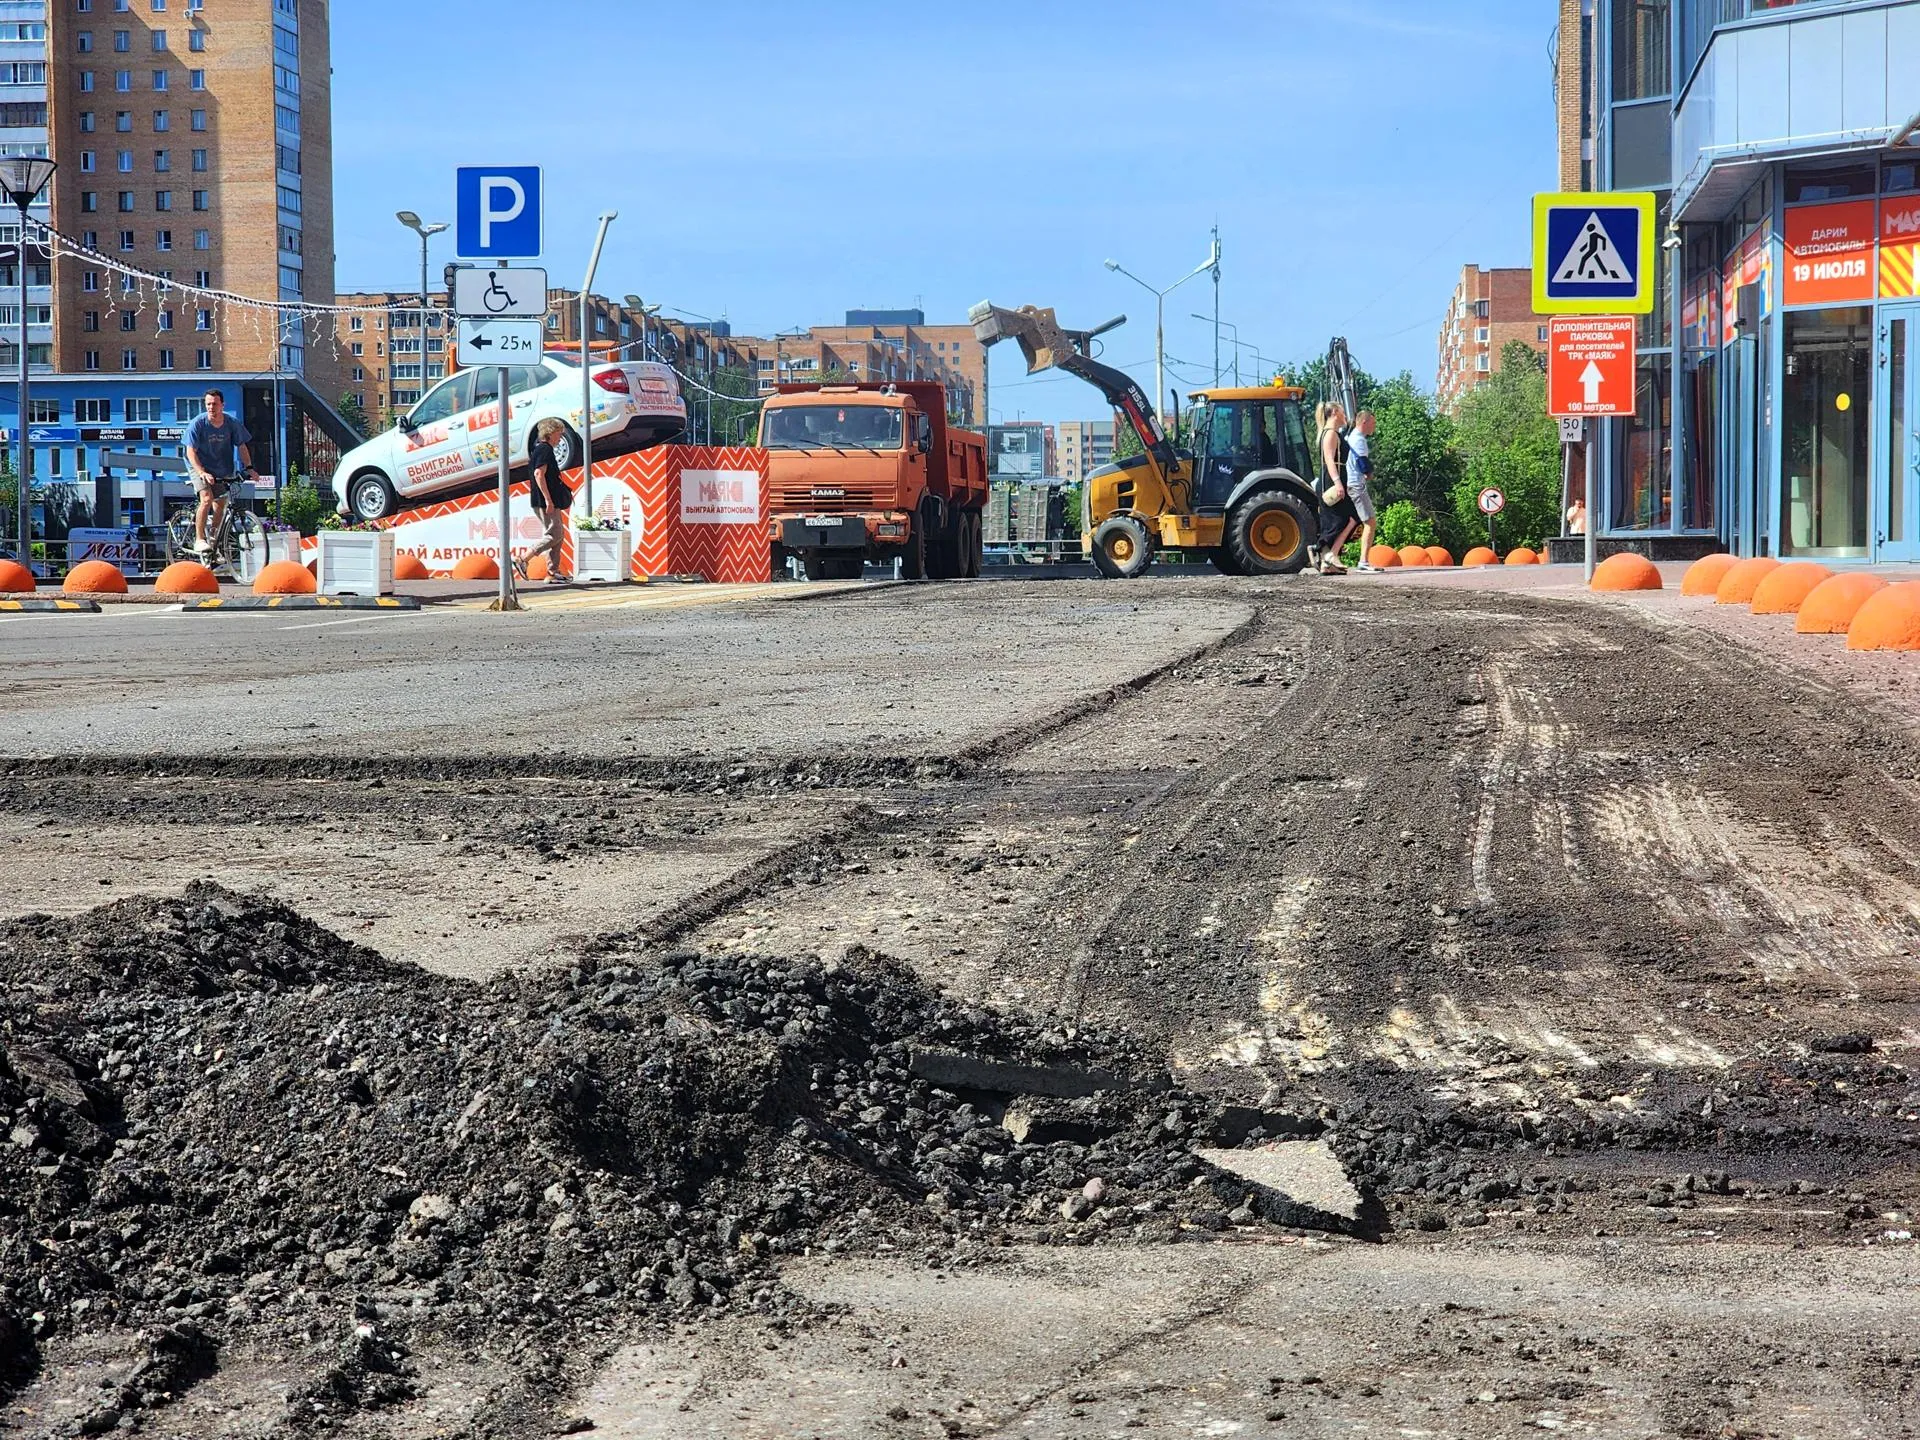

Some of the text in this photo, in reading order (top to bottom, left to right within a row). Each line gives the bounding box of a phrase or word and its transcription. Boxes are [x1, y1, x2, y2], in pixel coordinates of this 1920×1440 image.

[479, 176, 526, 248] P
[1811, 227, 1848, 241] ДАРИМ
[1793, 259, 1866, 282] 19 ИЮЛЯ
[1553, 322, 1631, 333] ДОПОЛНИТЕЛЬНАЯ
[501, 335, 519, 350] 25
[1570, 332, 1614, 341] ПАРКОВКА
[1559, 341, 1625, 352] для посетителей
[1568, 351, 1616, 360] ТРК «МАЯК»
[1568, 403, 1616, 412] 100 метров
[1563, 418, 1579, 430] 50
[407, 451, 462, 477] ВЫИГРАЙ
[685, 505, 715, 514] ВЫИГРАЙ
[469, 516, 543, 540] МАК
